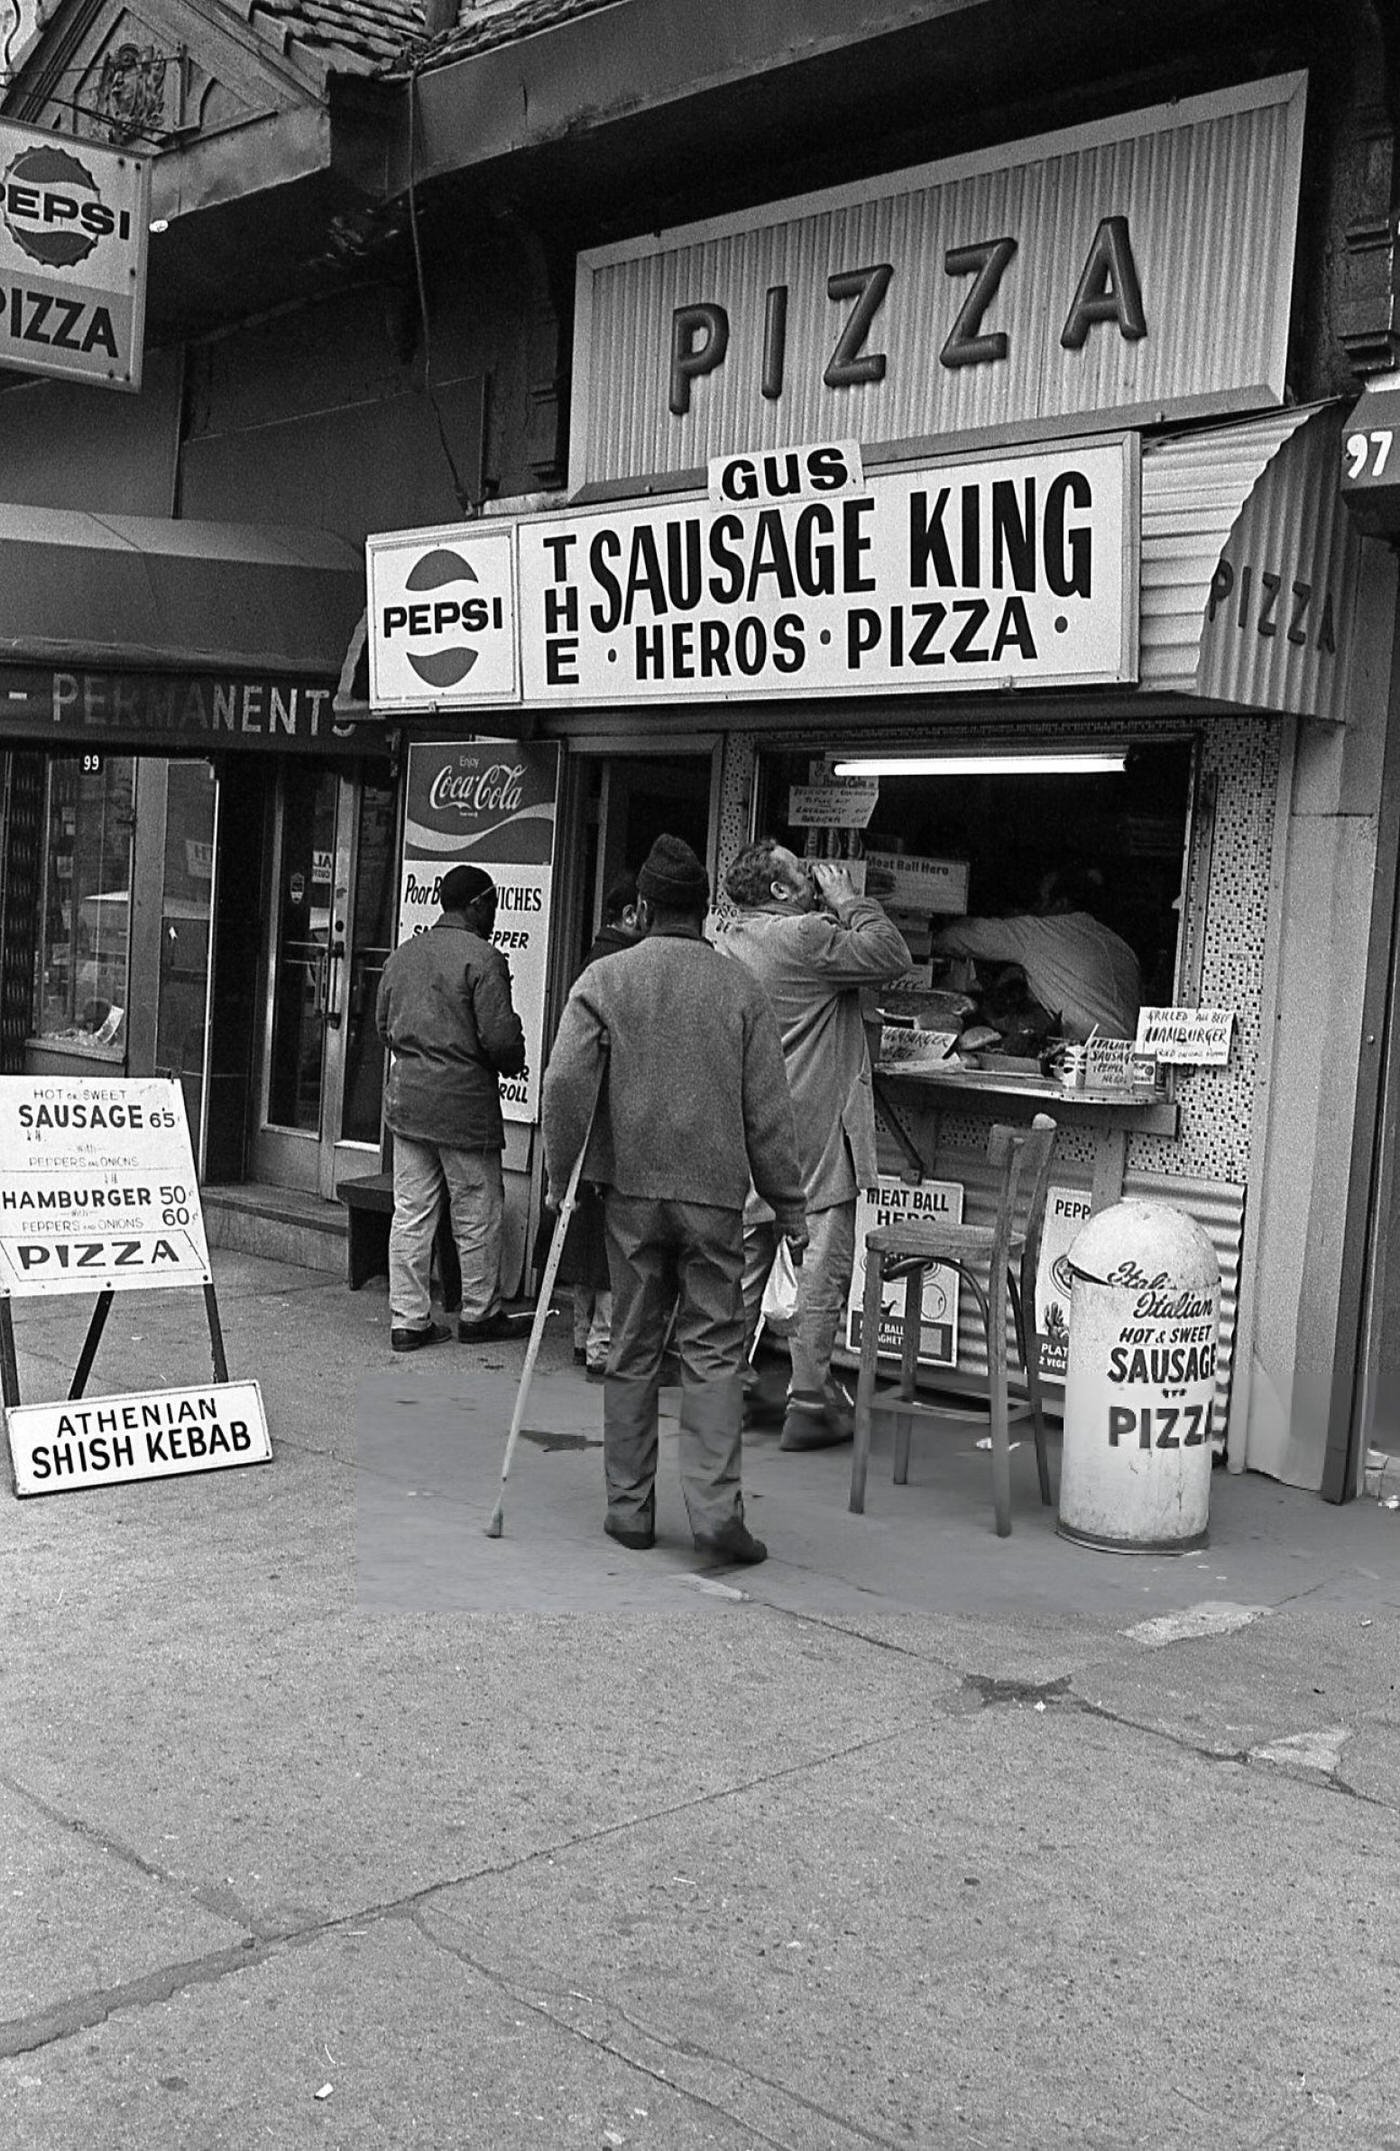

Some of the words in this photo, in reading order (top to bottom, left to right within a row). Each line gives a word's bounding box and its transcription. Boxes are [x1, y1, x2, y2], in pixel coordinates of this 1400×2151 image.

[0, 183, 130, 241] EPSI
[0, 287, 119, 358] IZZA
[669, 216, 1148, 415] PIZZA
[1346, 431, 1393, 479] 97
[722, 448, 848, 501] GUS
[589, 497, 876, 634] SAUSAGE
[910, 471, 1092, 599] KING
[383, 597, 503, 638] PEPSI
[543, 534, 580, 685] THE
[1209, 558, 1336, 655] PIZZA
[635, 613, 806, 681] HEROS
[847, 597, 1038, 669] PIZZA
[84, 756, 100, 770] 99
[488, 930, 529, 949] EPPER
[1145, 1026, 1228, 1047] HAMBURGER
[33, 1089, 63, 1100] HOT
[83, 1089, 127, 1101] SWEET
[500, 1083, 528, 1104] ROLL
[18, 1104, 144, 1129] SAUSAGE
[2, 1187, 152, 1210] HAMBURGER
[913, 1191, 949, 1212] BALL
[22, 1219, 80, 1233] PEPPERS
[98, 1216, 145, 1230] ONIONS
[17, 1239, 181, 1271] PIZZA
[1133, 1290, 1213, 1320] Italian
[1041, 1343, 1068, 1358] PLAT
[1119, 1327, 1156, 1344] HOT
[1169, 1324, 1213, 1344] SWEET
[1107, 1343, 1216, 1384] SAUSAGE
[57, 1397, 218, 1438] ATHENIAN
[31, 1434, 135, 1479] SHISH
[146, 1421, 252, 1463] KEBAB
